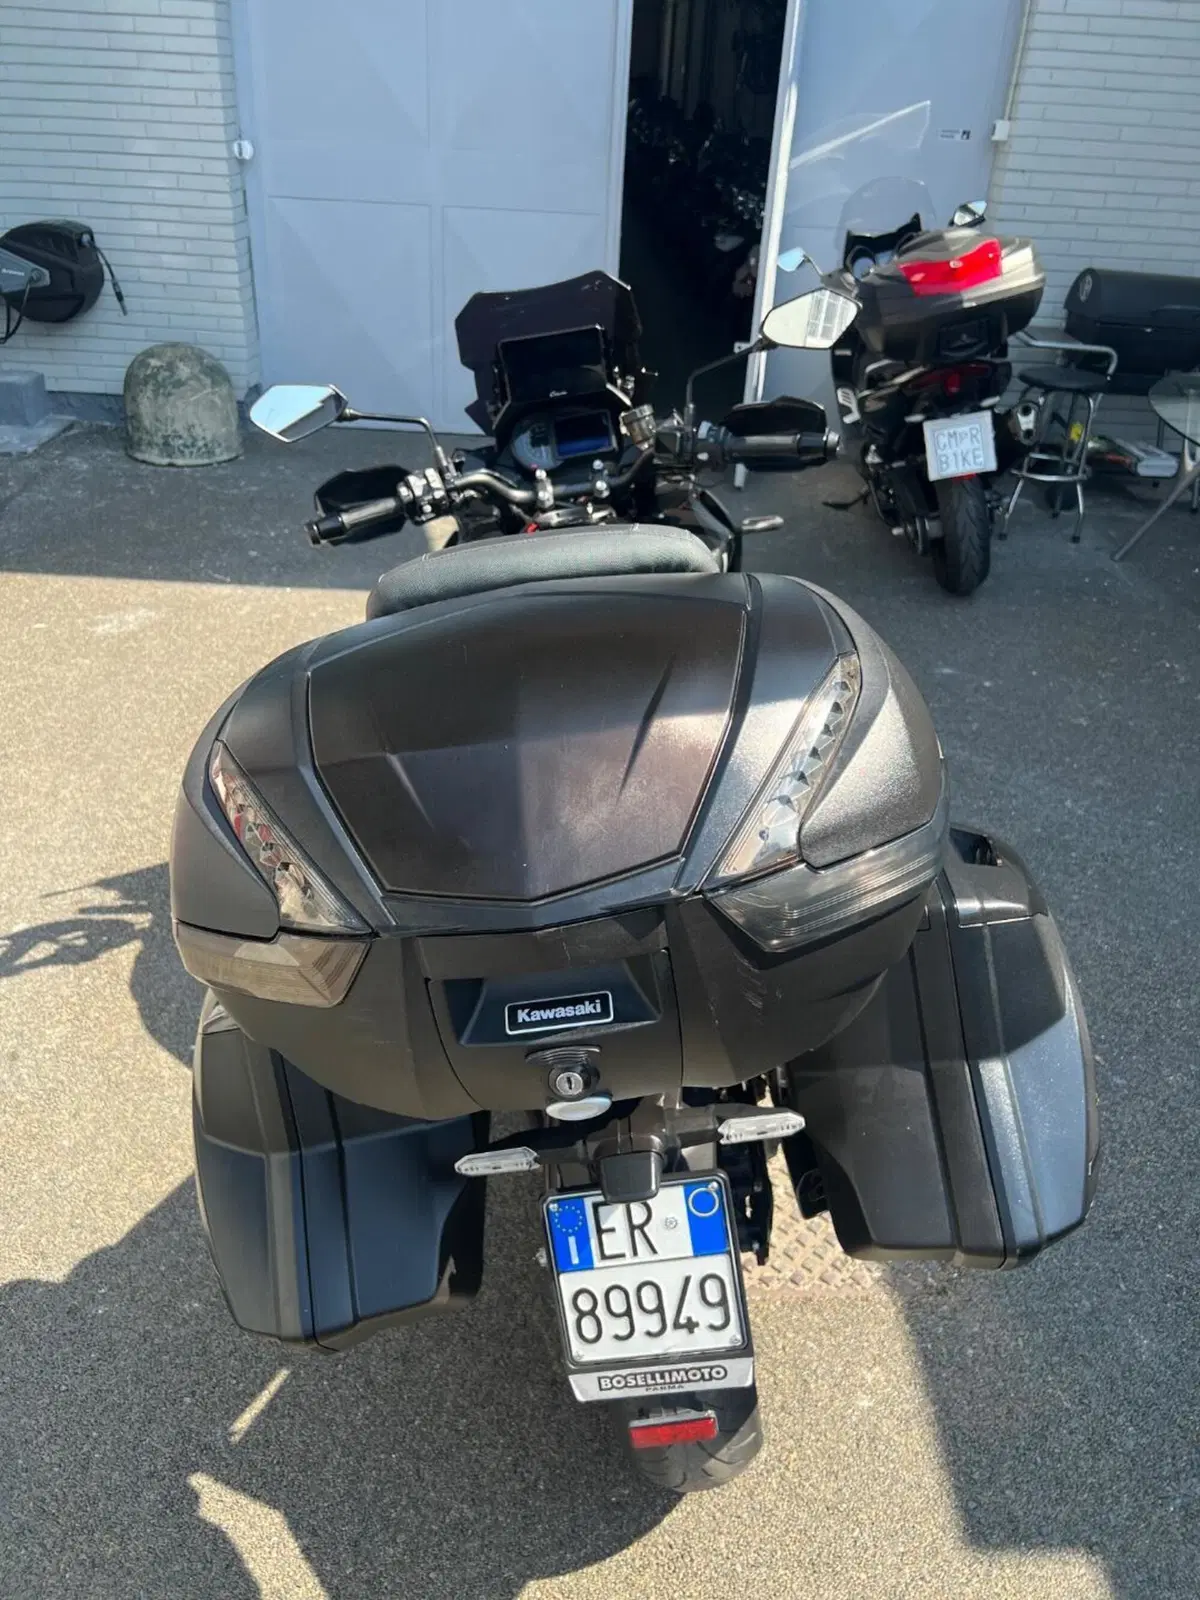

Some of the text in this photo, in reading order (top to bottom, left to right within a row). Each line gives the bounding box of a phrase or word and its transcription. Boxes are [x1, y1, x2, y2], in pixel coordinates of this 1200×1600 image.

[938, 448, 983, 473] BIKE
[517, 1000, 602, 1023] Kawasaki
[591, 1201, 658, 1261] ER
[568, 1235, 580, 1265] I
[571, 1272, 732, 1345] 89949
[599, 1364, 728, 1391] BOSELLIMOTO
